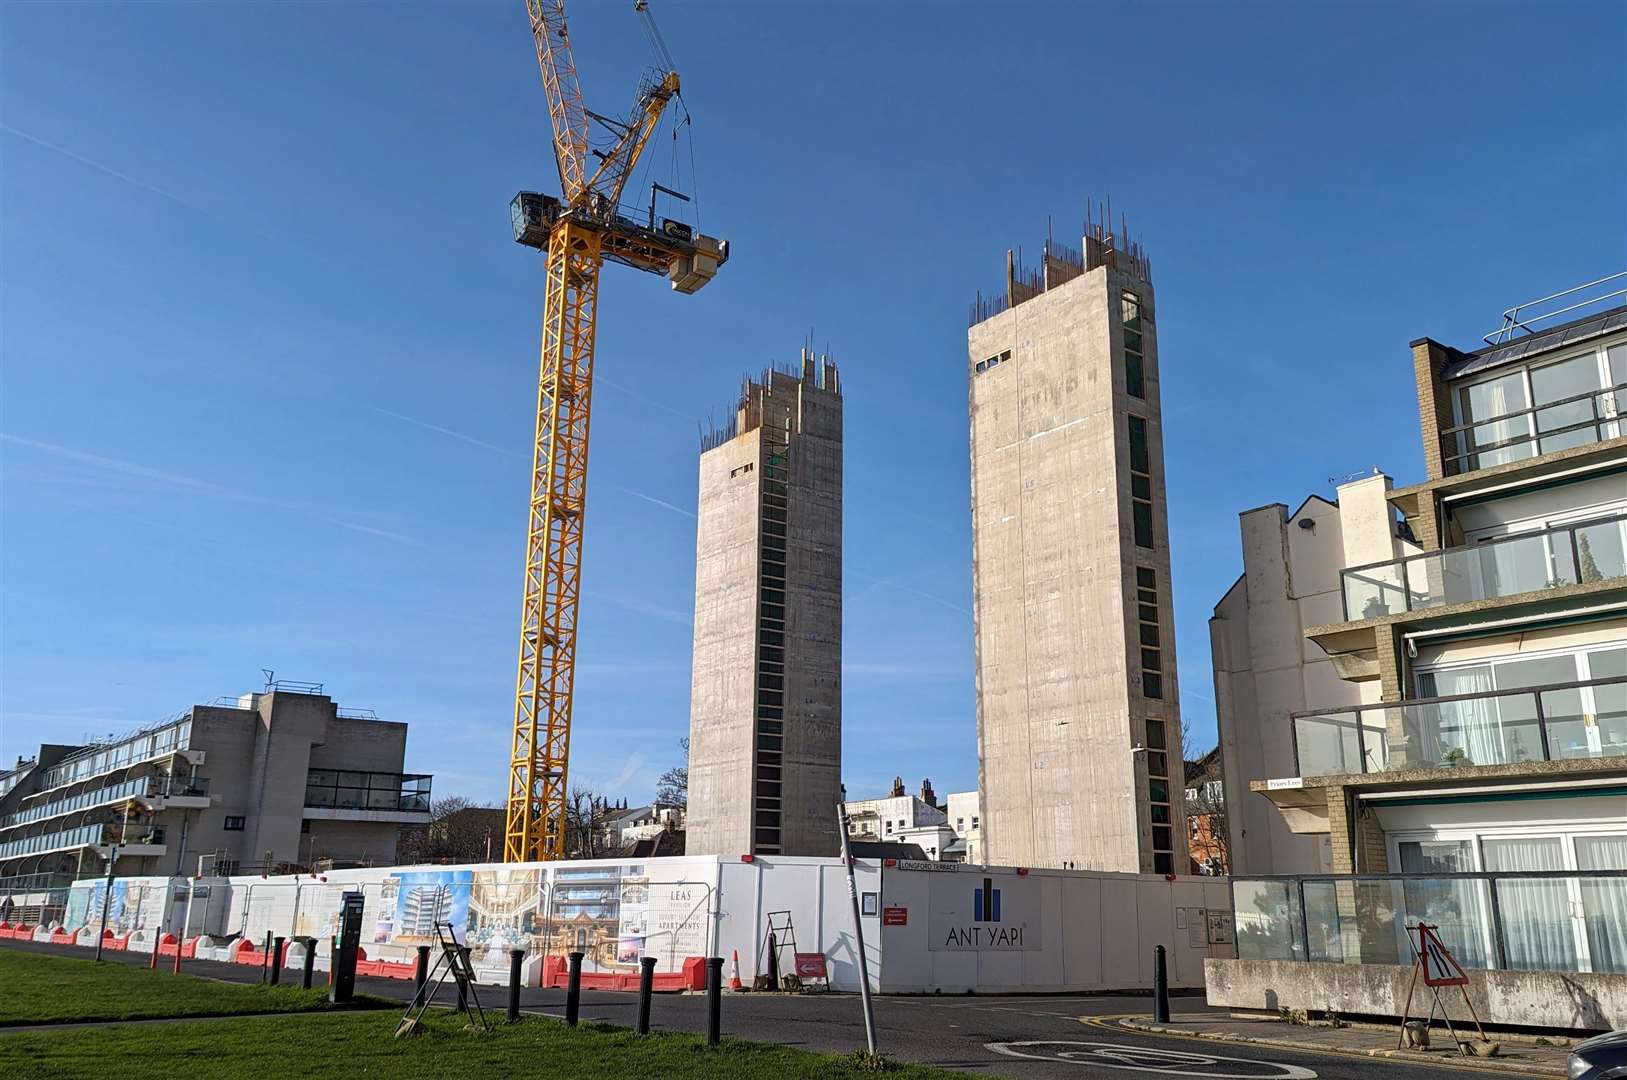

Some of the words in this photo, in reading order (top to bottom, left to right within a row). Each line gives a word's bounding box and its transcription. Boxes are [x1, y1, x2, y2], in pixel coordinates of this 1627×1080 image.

[901, 862, 932, 870] LONGFORD
[933, 863, 958, 871] TERRACE
[670, 890, 691, 901] LEAS
[658, 922, 700, 930] APARTMENTS
[945, 927, 981, 946] ANT
[988, 927, 1024, 946] YAPI
